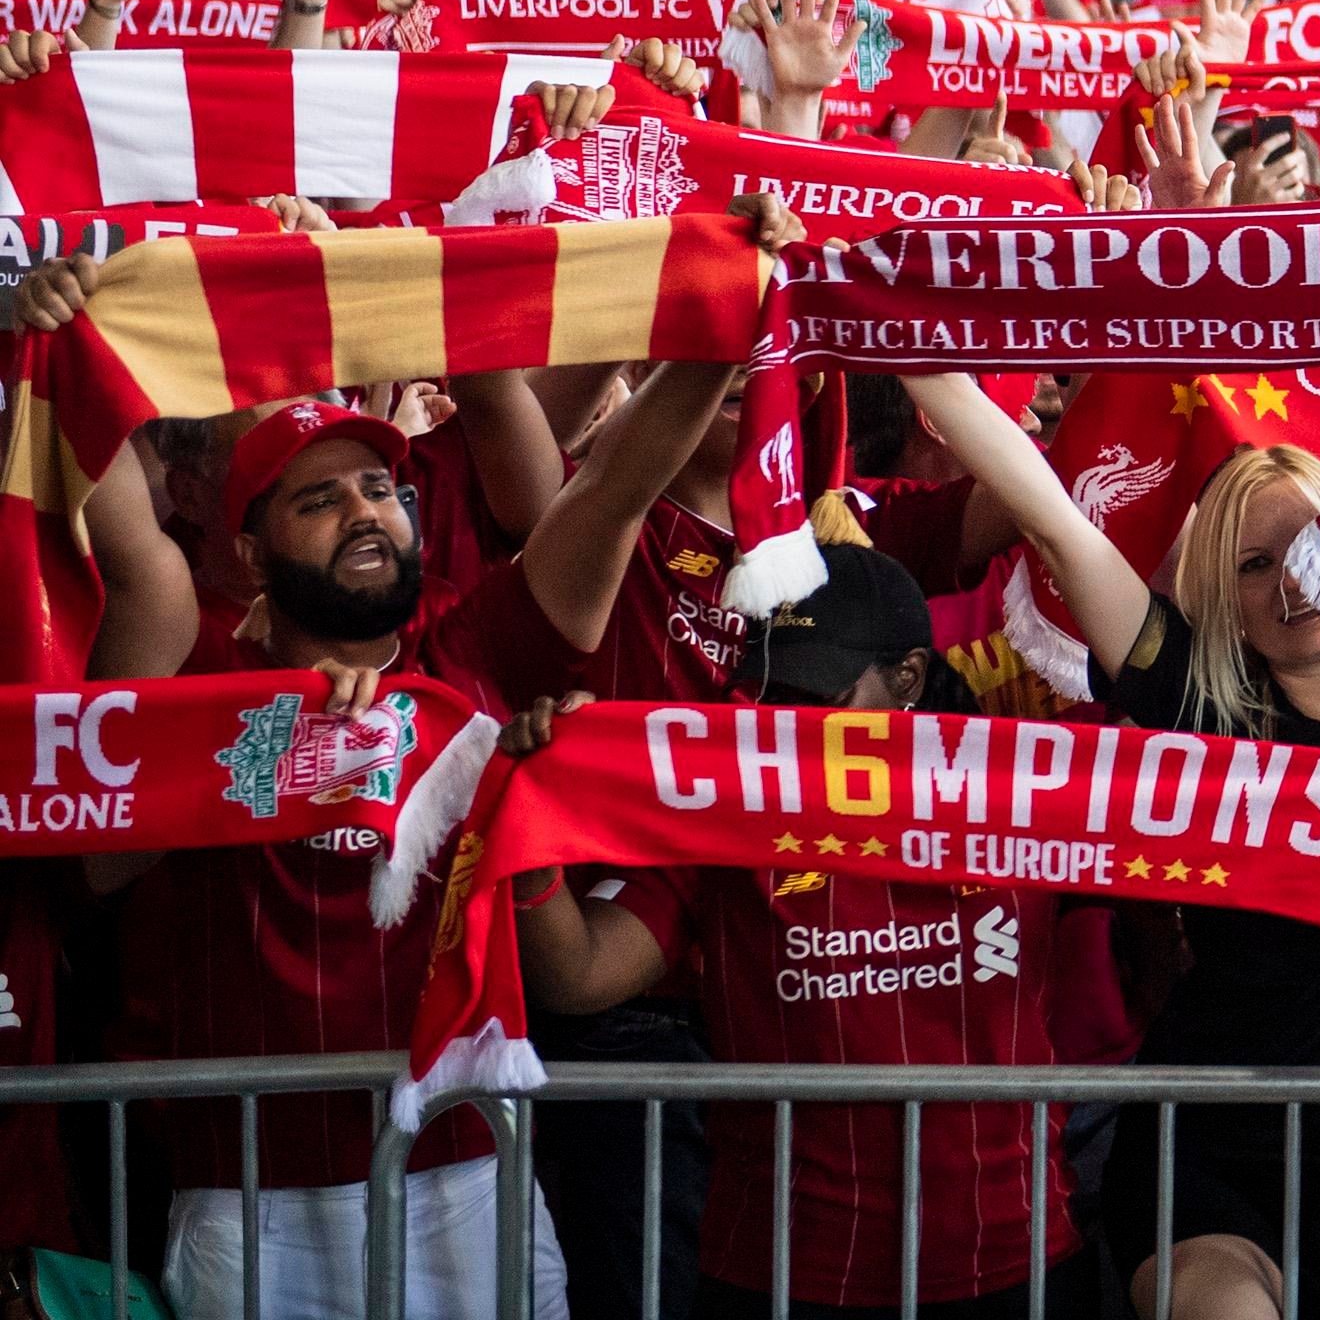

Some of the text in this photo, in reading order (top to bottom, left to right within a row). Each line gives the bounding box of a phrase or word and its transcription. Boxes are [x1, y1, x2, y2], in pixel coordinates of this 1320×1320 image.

[926, 8, 1202, 73] LIVERPO
[582, 136, 599, 208] FOOTBALL CLUB
[600, 137, 623, 212] LIVERPOOL
[1001, 318, 1090, 350] LFC
[32, 689, 140, 789] FC
[901, 829, 1116, 887] OF EUROPE
[785, 912, 960, 961] Standard
[776, 955, 963, 1004] Chartered
